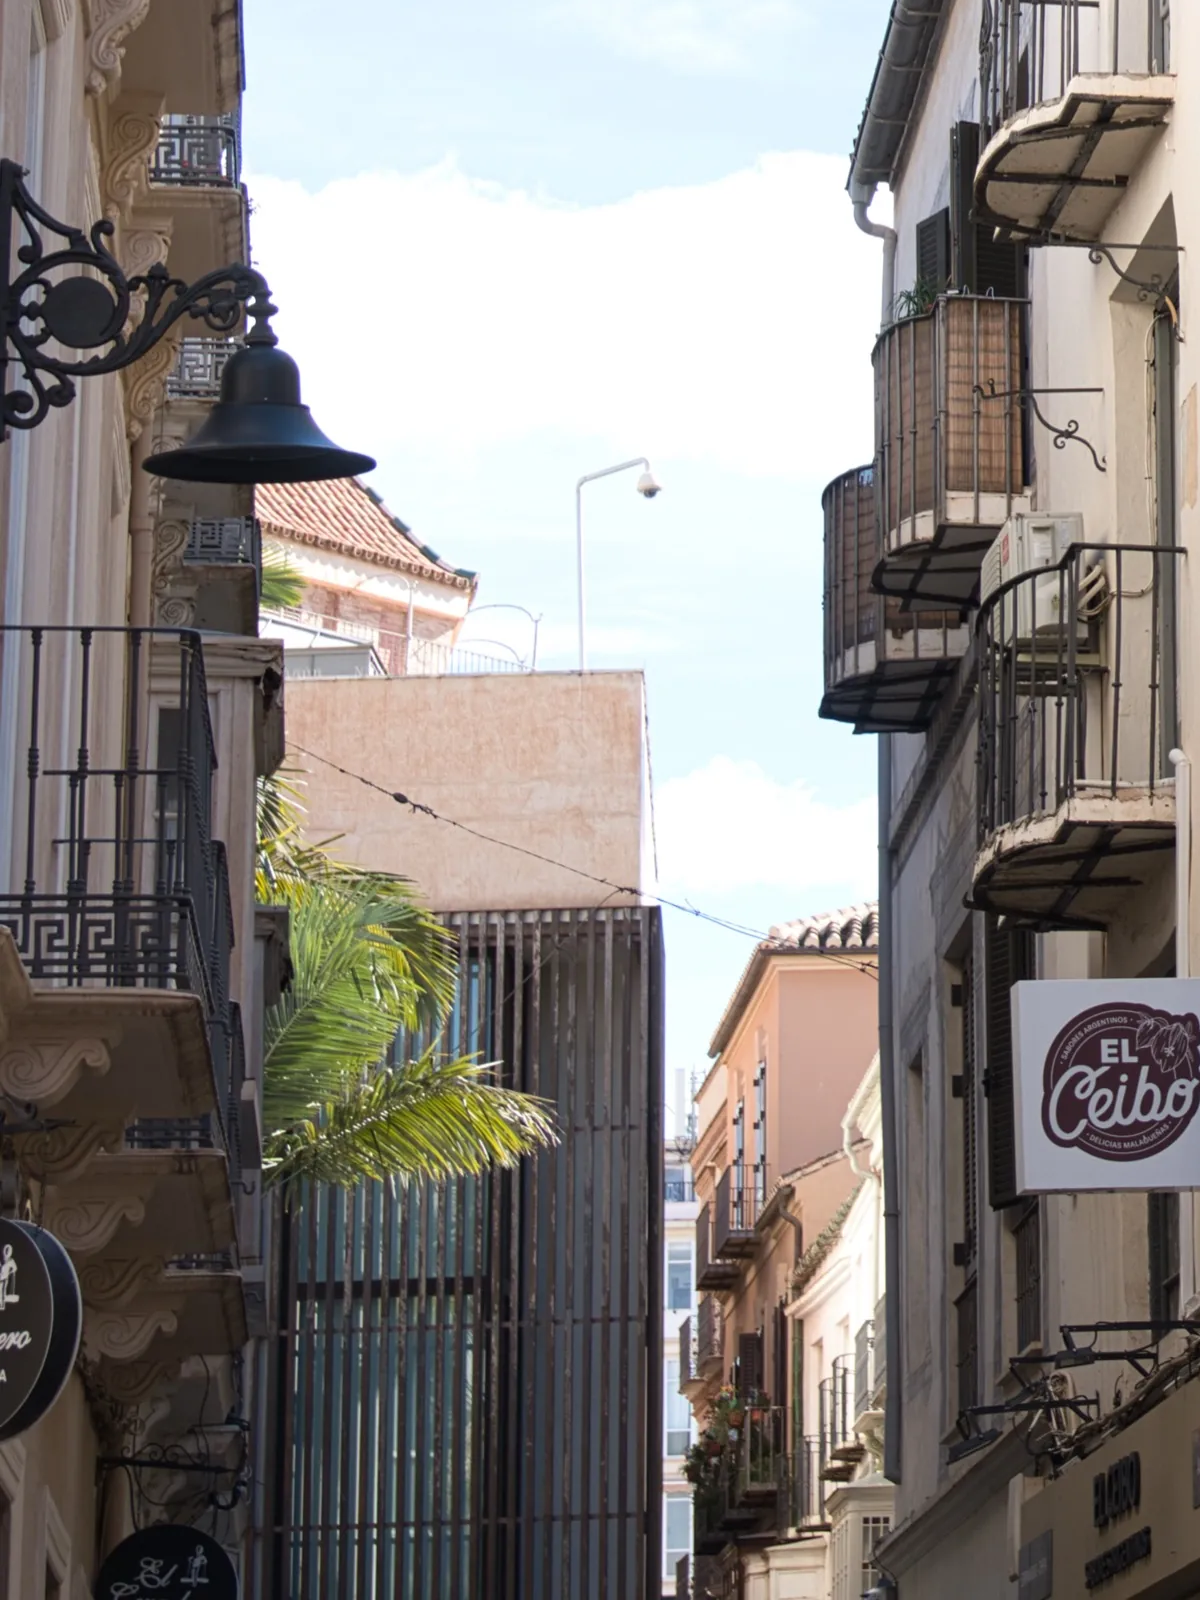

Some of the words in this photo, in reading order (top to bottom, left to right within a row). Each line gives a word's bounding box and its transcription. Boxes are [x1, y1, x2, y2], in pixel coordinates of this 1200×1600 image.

[1061, 1030, 1084, 1060] SABORES
[1083, 1016, 1129, 1035] ARGENTINOS
[1100, 1038, 1139, 1064] EL
[1048, 1064, 1200, 1141] Ceibo
[1089, 1134, 1122, 1149] DELICIAS
[134, 1557, 179, 1589] El
